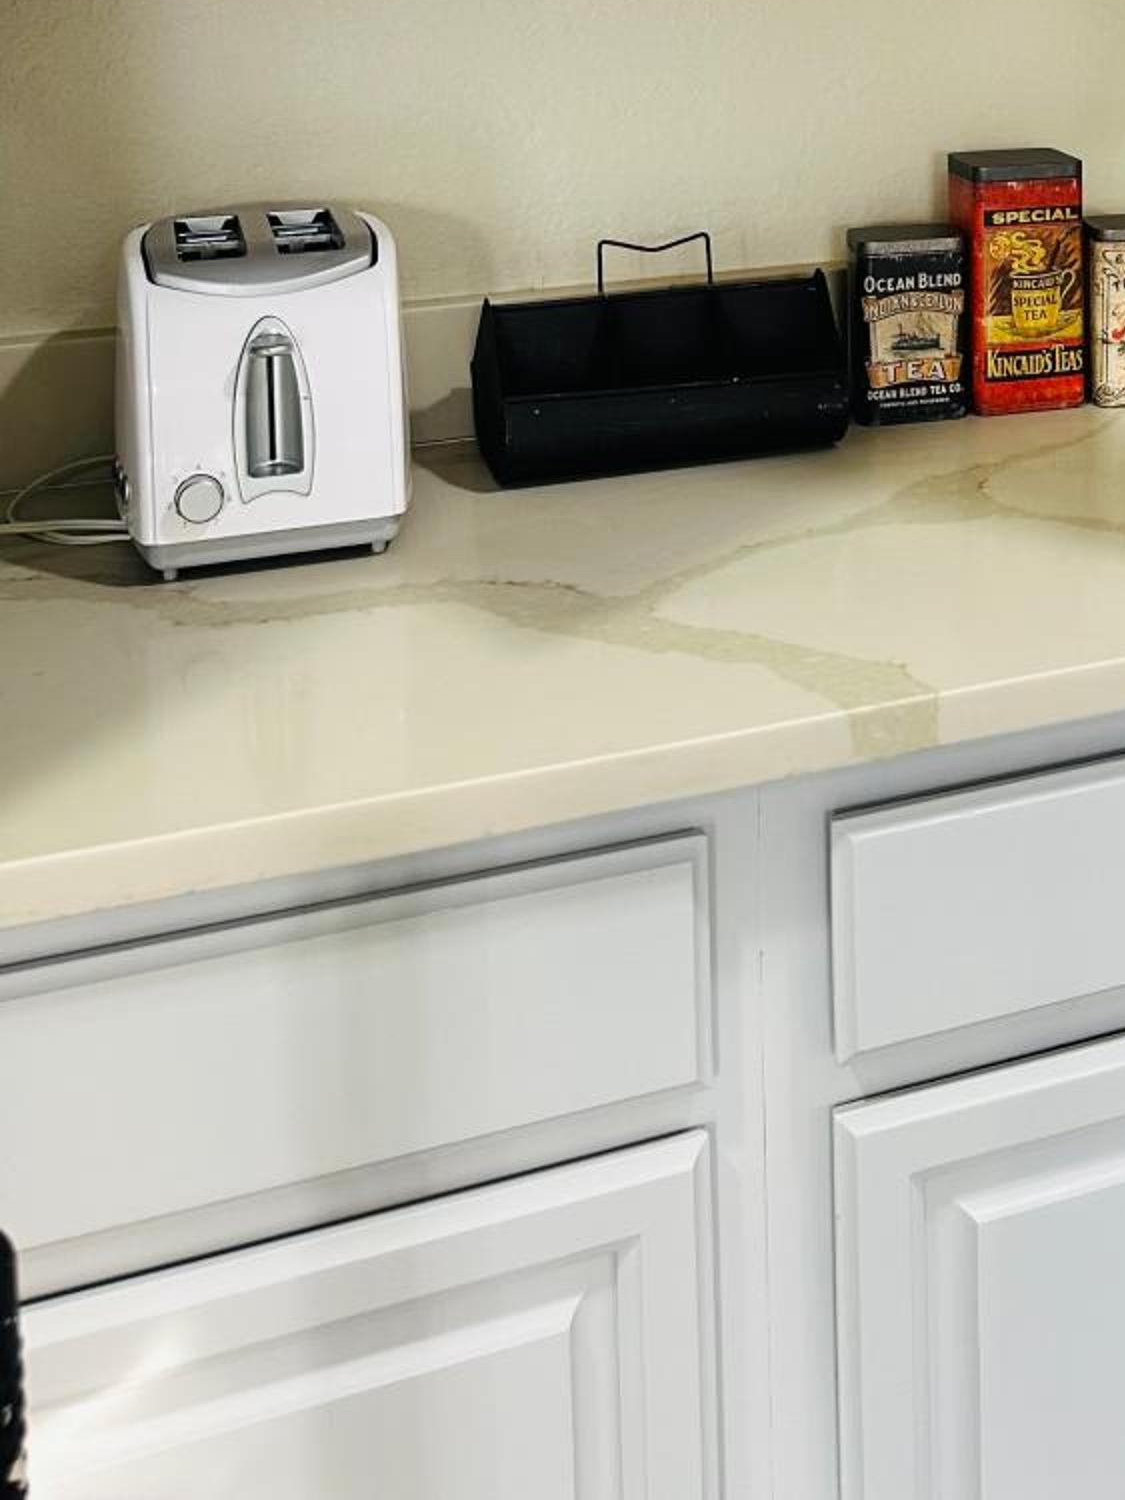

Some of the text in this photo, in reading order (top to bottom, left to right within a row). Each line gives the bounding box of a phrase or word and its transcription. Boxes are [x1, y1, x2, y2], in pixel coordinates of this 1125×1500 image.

[992, 207, 1079, 225] SPECIAL
[864, 272, 962, 293] OCEAN BLEND
[1013, 293, 1057, 308] SPECIAL
[1024, 309, 1048, 321] TEA
[987, 344, 1083, 379] KINCAID'S TEAS
[884, 359, 946, 383] TEA
[867, 388, 898, 402] OCEAN
[899, 386, 927, 399] BLEND
[930, 384, 947, 396] TEA
